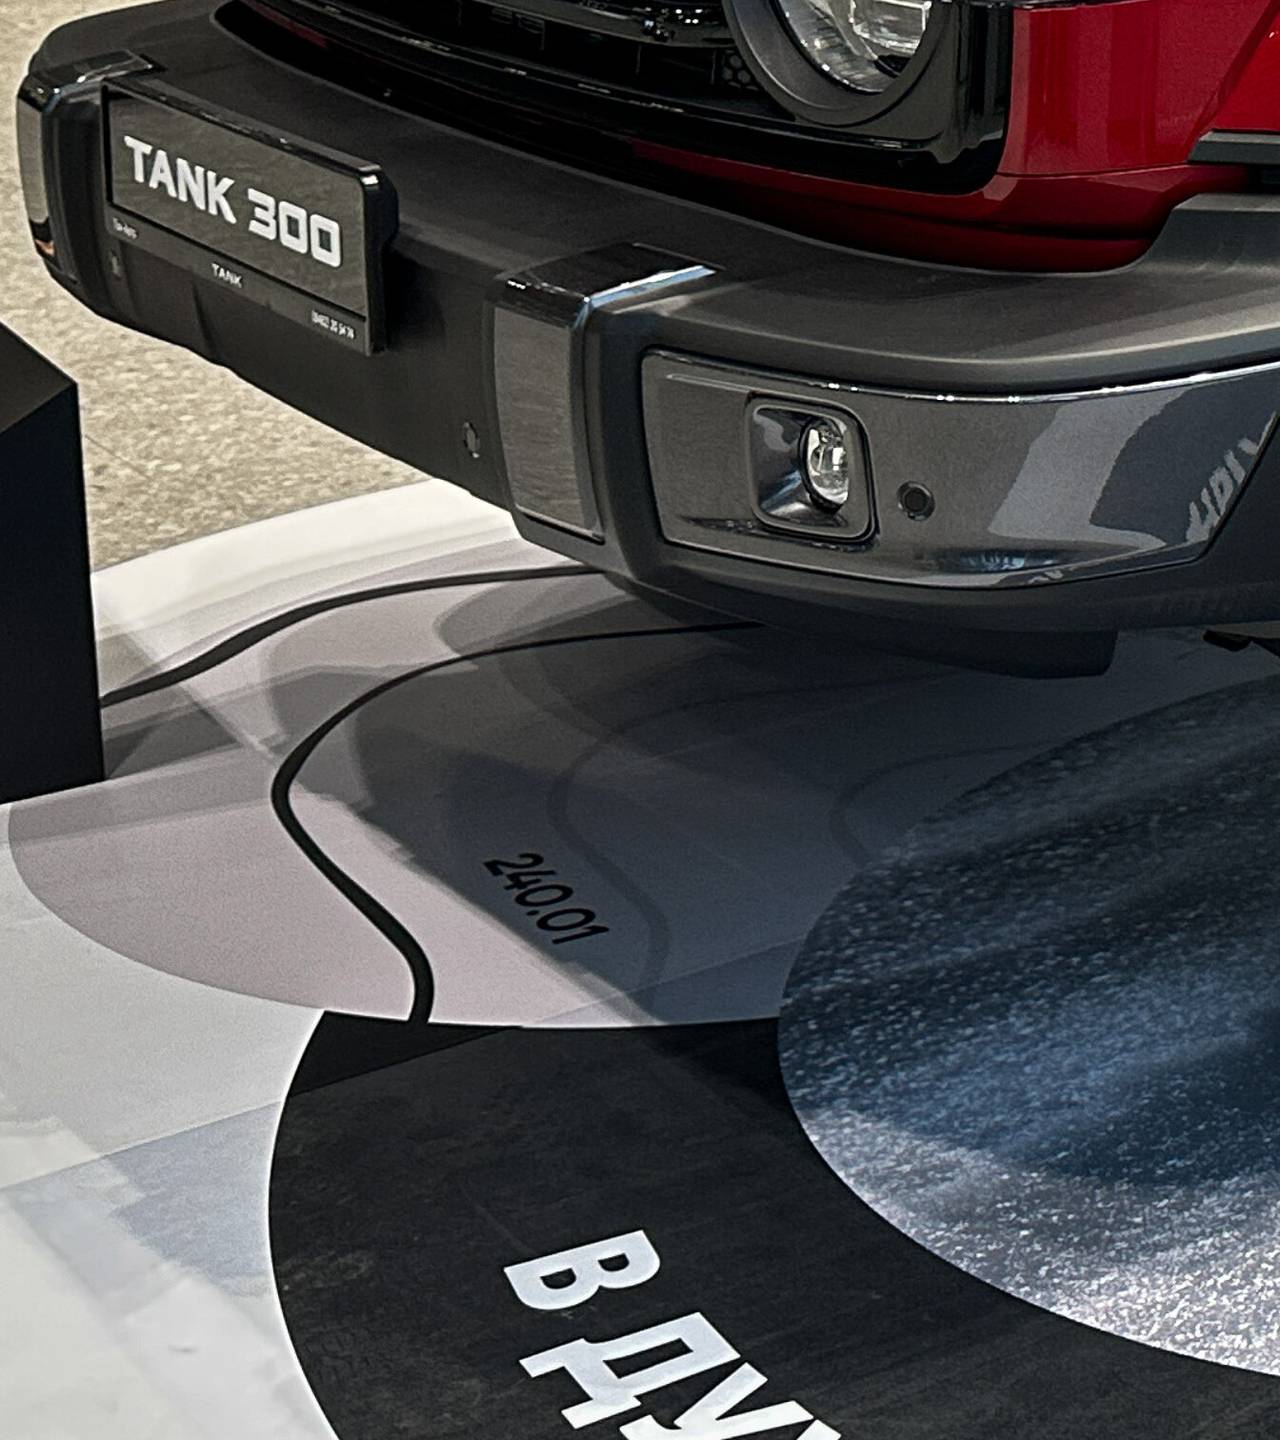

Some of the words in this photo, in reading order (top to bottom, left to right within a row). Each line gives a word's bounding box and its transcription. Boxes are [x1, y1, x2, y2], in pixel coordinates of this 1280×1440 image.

[124, 135, 237, 224] TANK
[247, 187, 342, 268] 300
[211, 262, 242, 288] TANK
[483, 853, 609, 944] 240.01
[504, 1229, 660, 1310] В
[518, 1311, 842, 1440] ДУ
